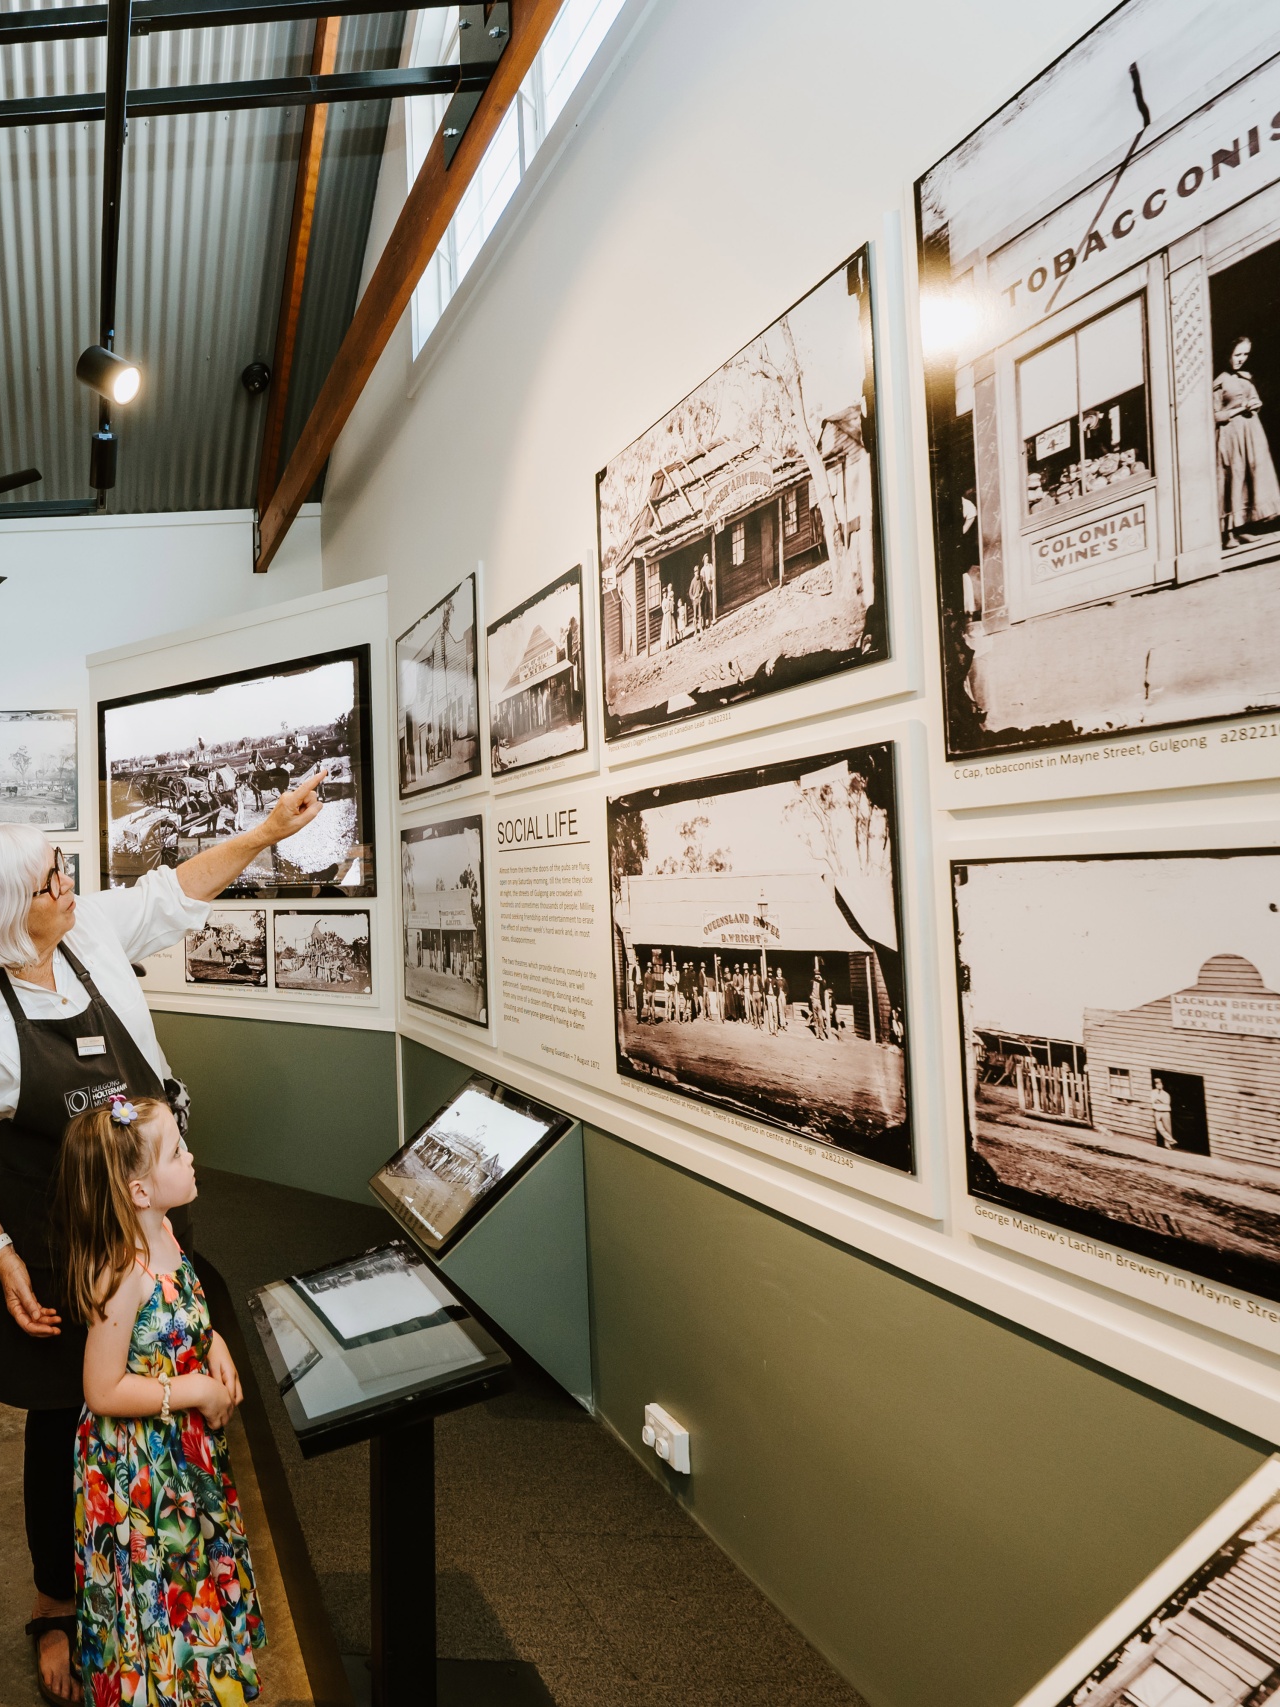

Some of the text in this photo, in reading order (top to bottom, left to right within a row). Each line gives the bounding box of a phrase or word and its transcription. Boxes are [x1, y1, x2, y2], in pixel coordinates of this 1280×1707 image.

[1039, 512, 1144, 558] COLONIAL
[1051, 537, 1118, 570] WINE'S
[954, 769, 960, 780] C
[963, 768, 982, 780] Cap,
[985, 759, 1043, 776] tobacconist
[1046, 756, 1056, 767] in
[1060, 751, 1099, 765] Mayne
[1103, 744, 1145, 759] Street,
[1149, 736, 1207, 753] Gulgong
[497, 809, 578, 845] SOCIAL LIFE
[753, 916, 780, 939] HTEL
[760, 1127, 765, 1136] in
[766, 1130, 783, 1143] centre
[785, 1137, 791, 1146] of
[792, 1139, 802, 1150] the
[803, 1146, 816, 1155] sign
[821, 1149, 854, 1168] a2822345
[974, 1205, 1010, 1226] George
[1012, 1217, 1065, 1245] Mathew's
[1068, 1236, 1112, 1262] Lachlan
[1116, 1254, 1170, 1285] Brewery
[1173, 1272, 1186, 1289] in
[1191, 1280, 1241, 1310] Mayne
